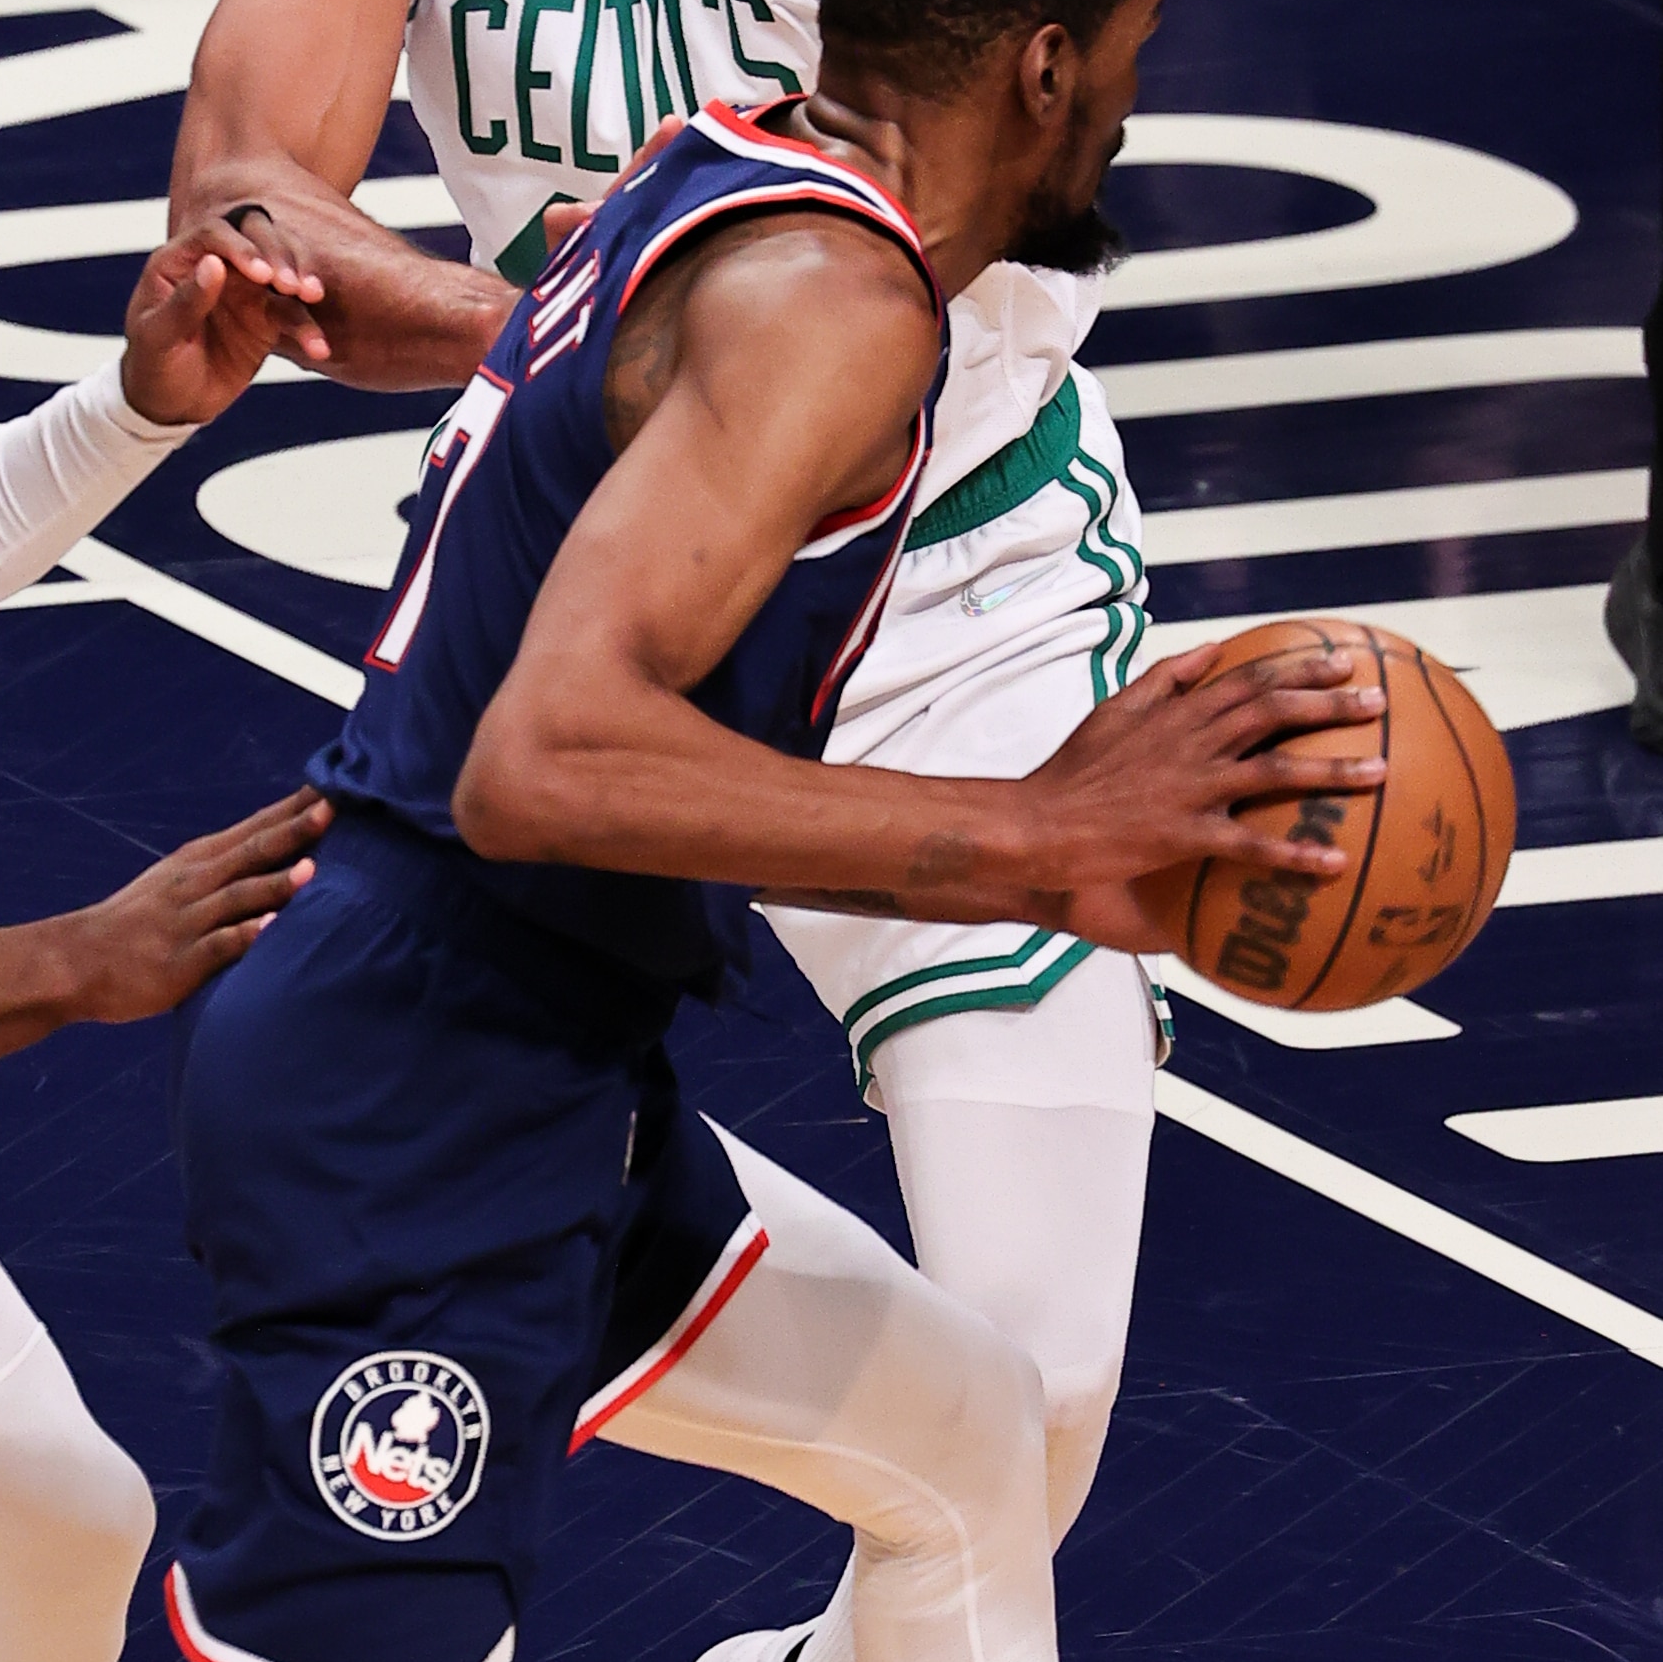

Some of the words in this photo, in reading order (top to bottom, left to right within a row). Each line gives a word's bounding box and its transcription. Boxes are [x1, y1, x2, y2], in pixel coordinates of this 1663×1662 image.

[363, 364, 515, 673] 7
[342, 1360, 483, 1441] BROOKLYN
[320, 1453, 370, 1515] NEW
[380, 1492, 455, 1531] YORK
[343, 1419, 454, 1497] Nets
